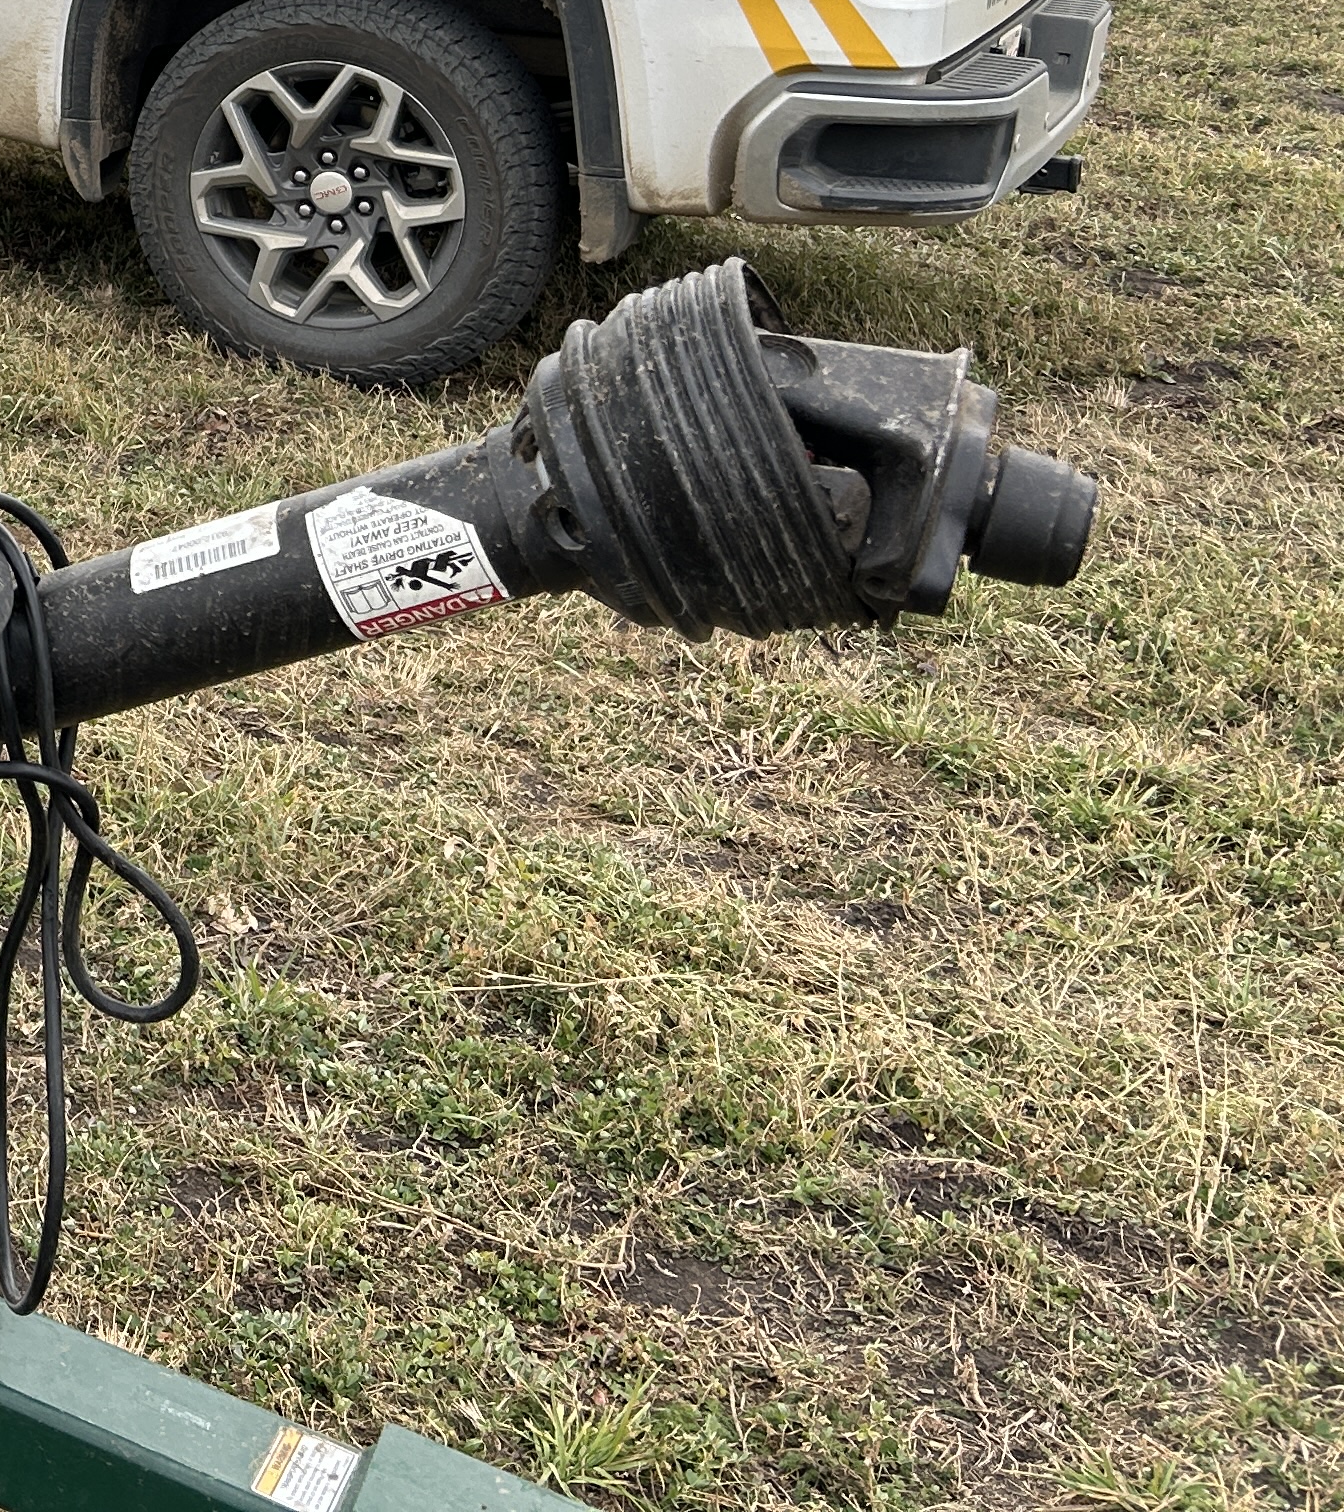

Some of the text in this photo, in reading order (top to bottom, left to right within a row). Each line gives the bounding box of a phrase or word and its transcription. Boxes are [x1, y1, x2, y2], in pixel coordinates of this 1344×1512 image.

[314, 183, 349, 203] GMC
[367, 510, 415, 527] OPERATE
[388, 515, 432, 534] KEEP
[340, 523, 446, 560] CONTACT CAN CAUSE DEATH
[345, 526, 395, 547] AWAY!
[330, 531, 465, 577] ROTATING DRIVE SHAFT
[359, 596, 466, 638] DANGER
